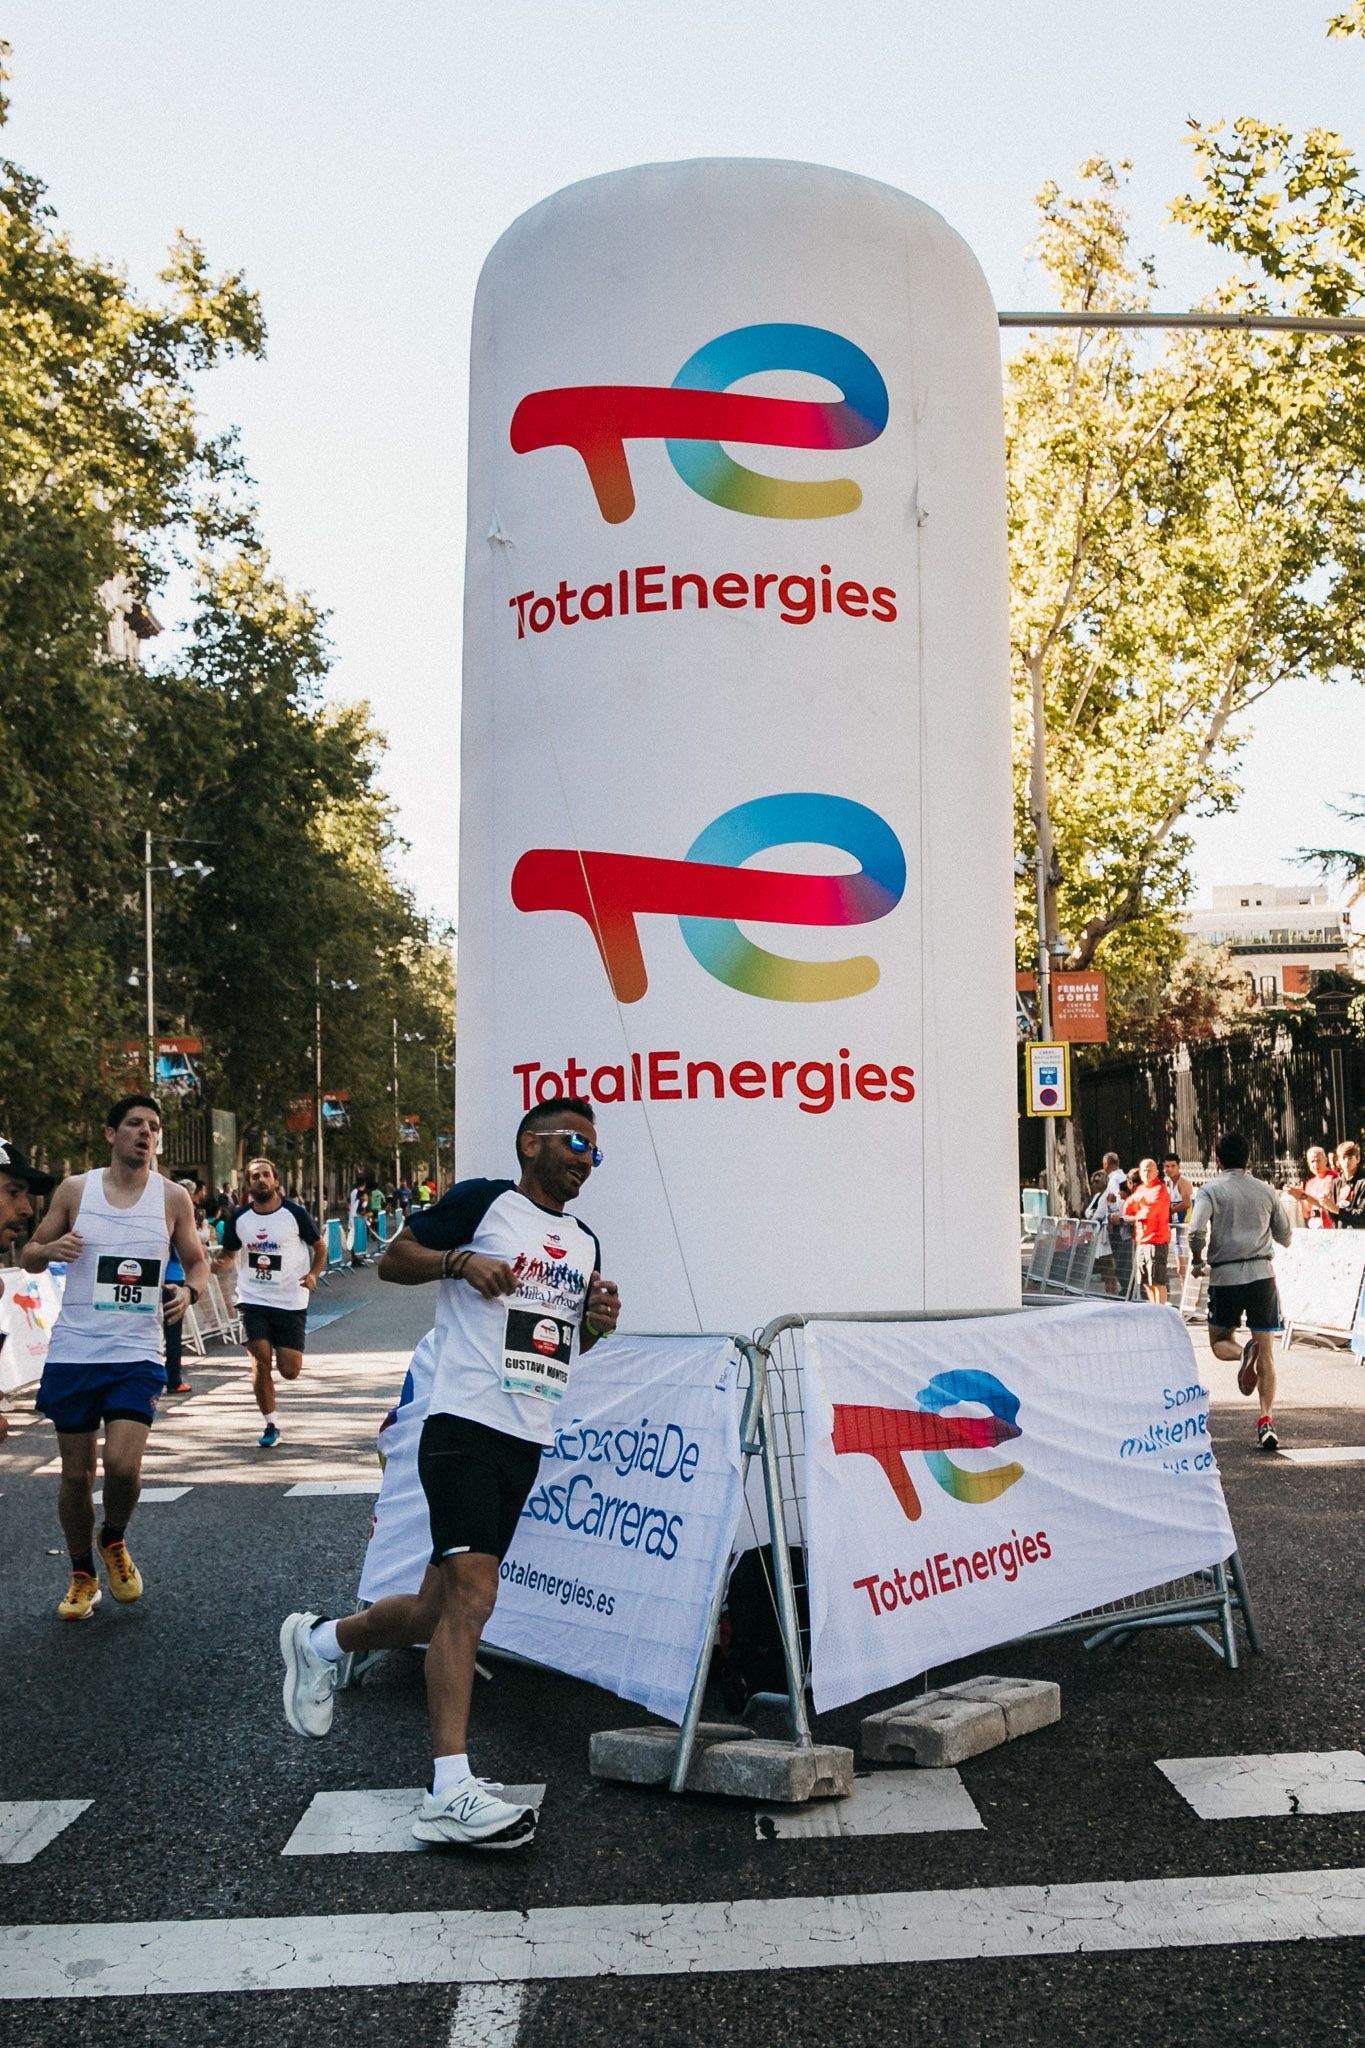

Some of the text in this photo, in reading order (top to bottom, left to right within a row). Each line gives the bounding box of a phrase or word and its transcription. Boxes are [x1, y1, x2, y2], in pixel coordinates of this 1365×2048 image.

[508, 564, 897, 639] TotalEnergies
[513, 1048, 916, 1114] TotalEnergies
[113, 1285, 143, 1304] 195
[519, 1474, 684, 1560] asCarreras
[854, 1529, 1052, 1617] TotalEnergies
